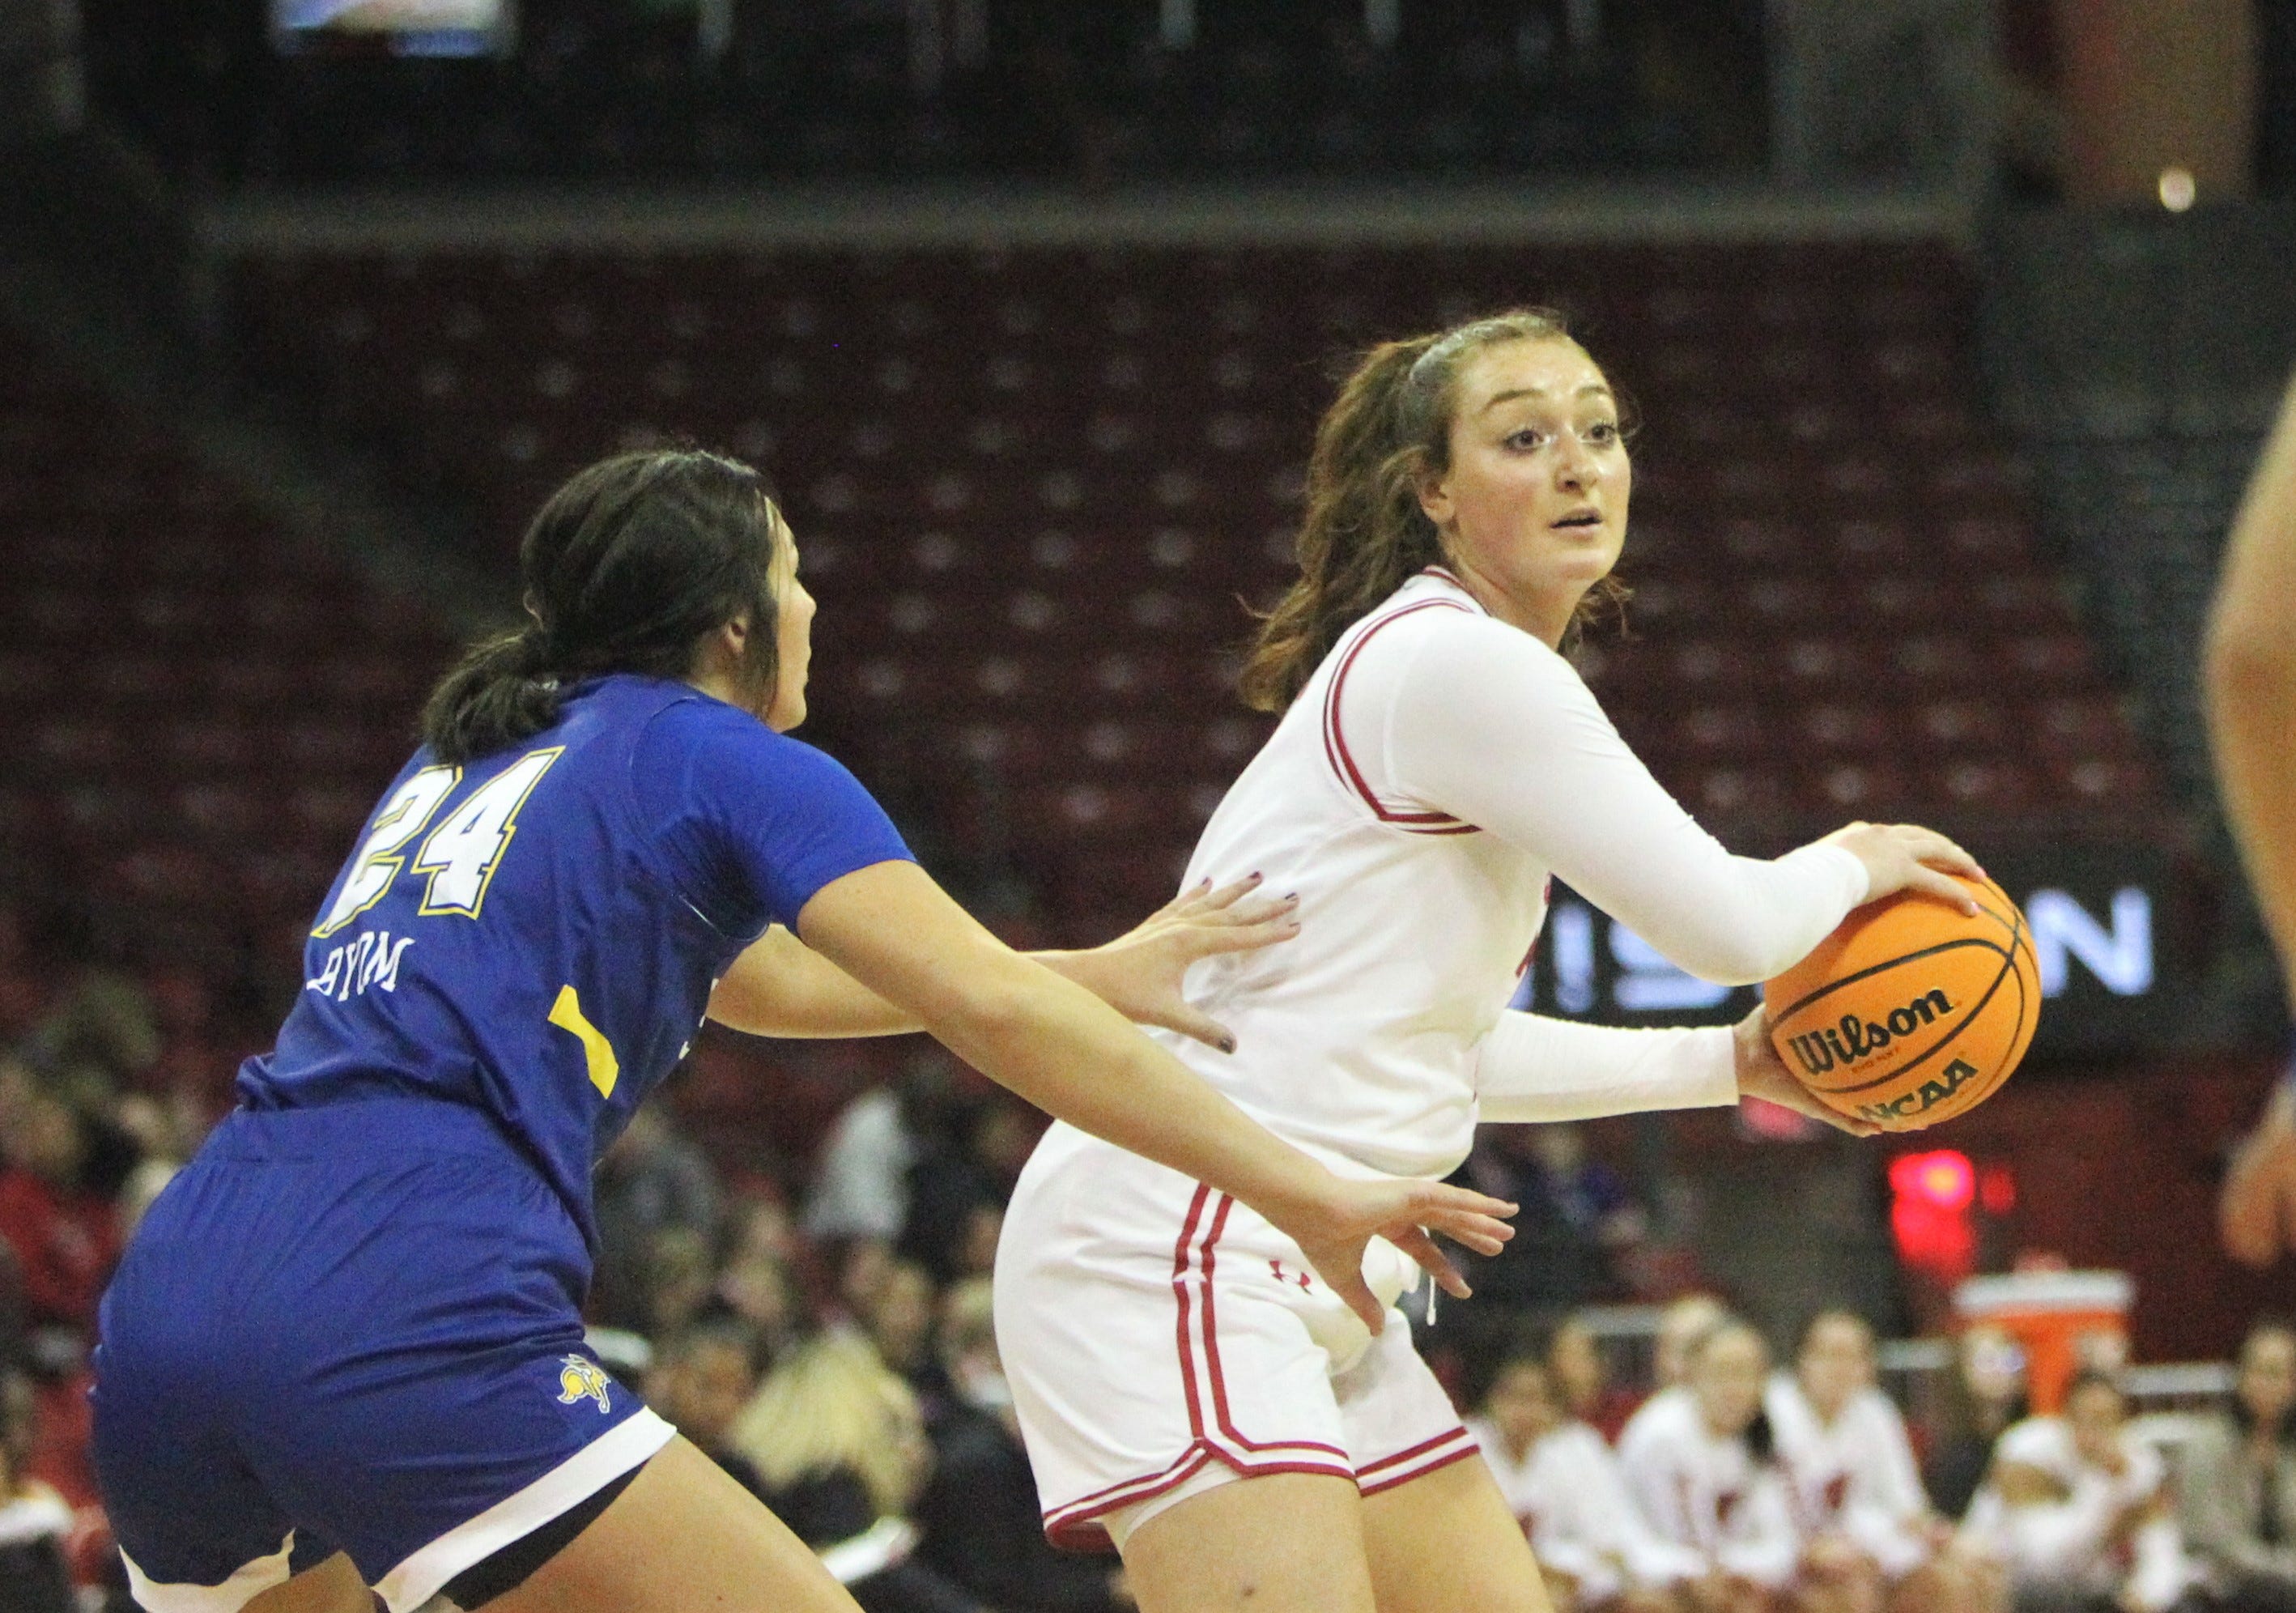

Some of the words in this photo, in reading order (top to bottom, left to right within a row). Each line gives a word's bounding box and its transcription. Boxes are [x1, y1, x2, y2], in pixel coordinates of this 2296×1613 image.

[310, 745, 565, 937] 24
[1788, 990, 1953, 1075] Wilson
[1857, 1059, 1978, 1117] NCAA
